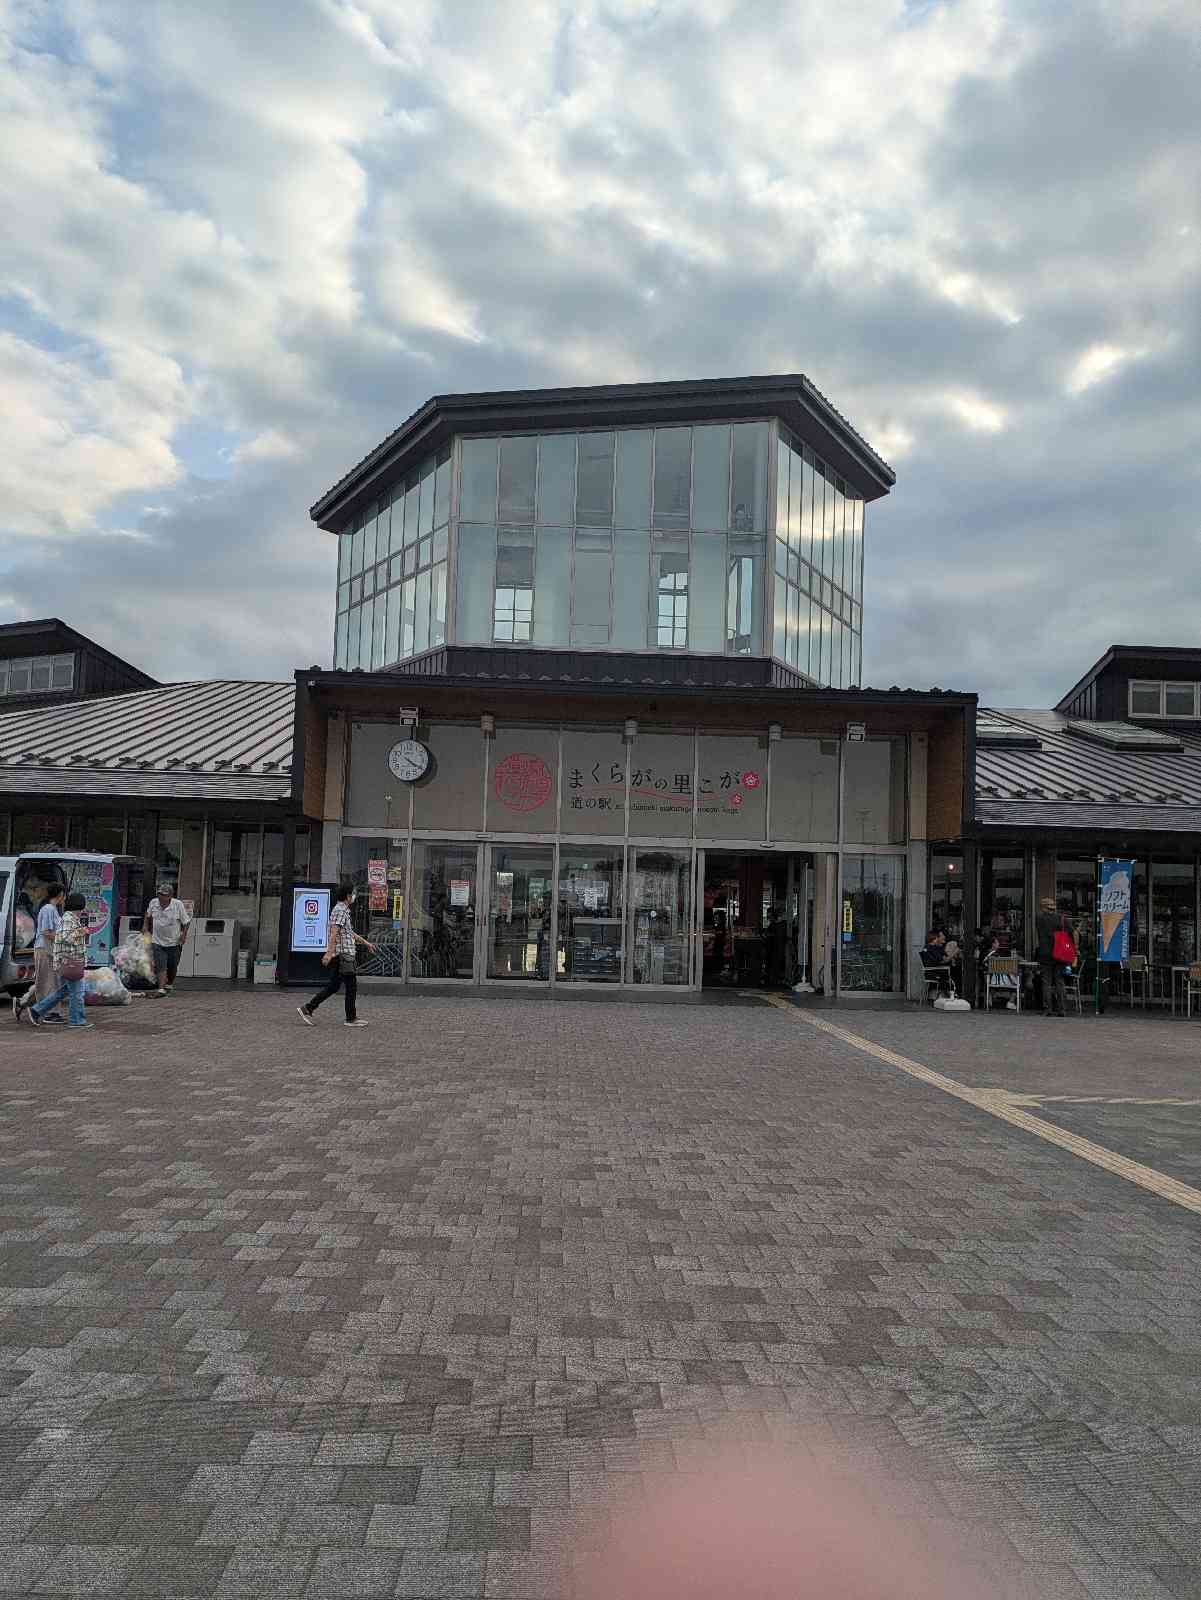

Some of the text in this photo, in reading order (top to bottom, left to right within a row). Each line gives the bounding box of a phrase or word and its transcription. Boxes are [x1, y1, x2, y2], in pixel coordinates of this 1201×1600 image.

[568, 762, 742, 795] まくらがの里こが
[570, 797, 612, 810] 道の駅
